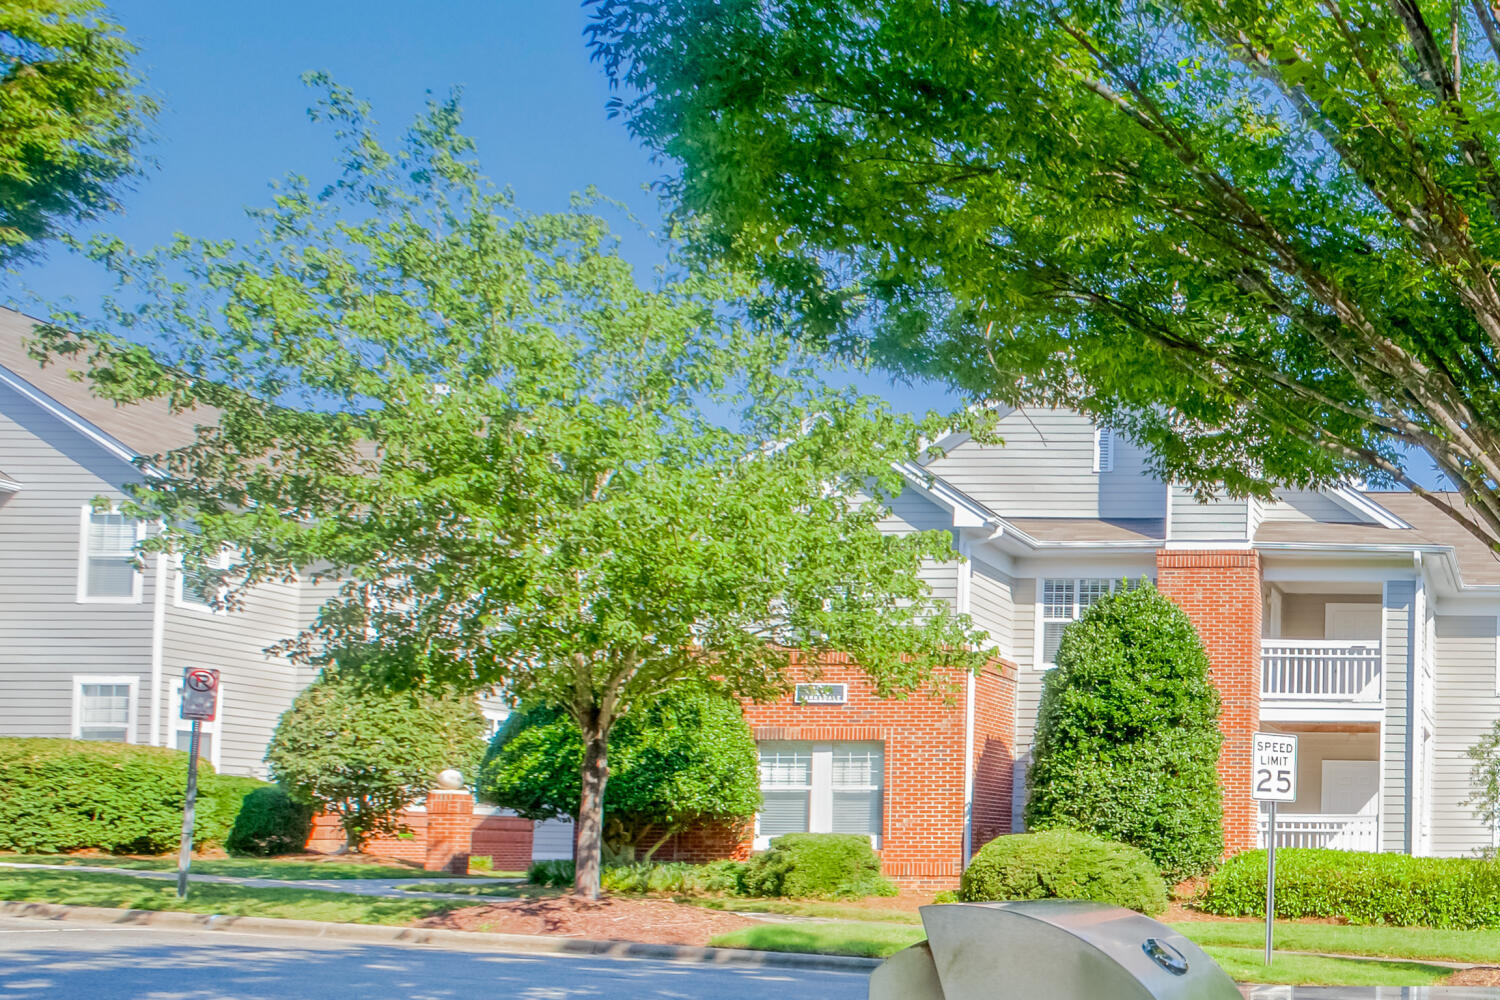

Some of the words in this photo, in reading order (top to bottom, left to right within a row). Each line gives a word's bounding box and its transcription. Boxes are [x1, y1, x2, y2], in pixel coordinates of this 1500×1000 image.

[1257, 741, 1293, 753] SPEED
[1260, 755, 1288, 766] LIMIT
[1257, 768, 1291, 793] 25
